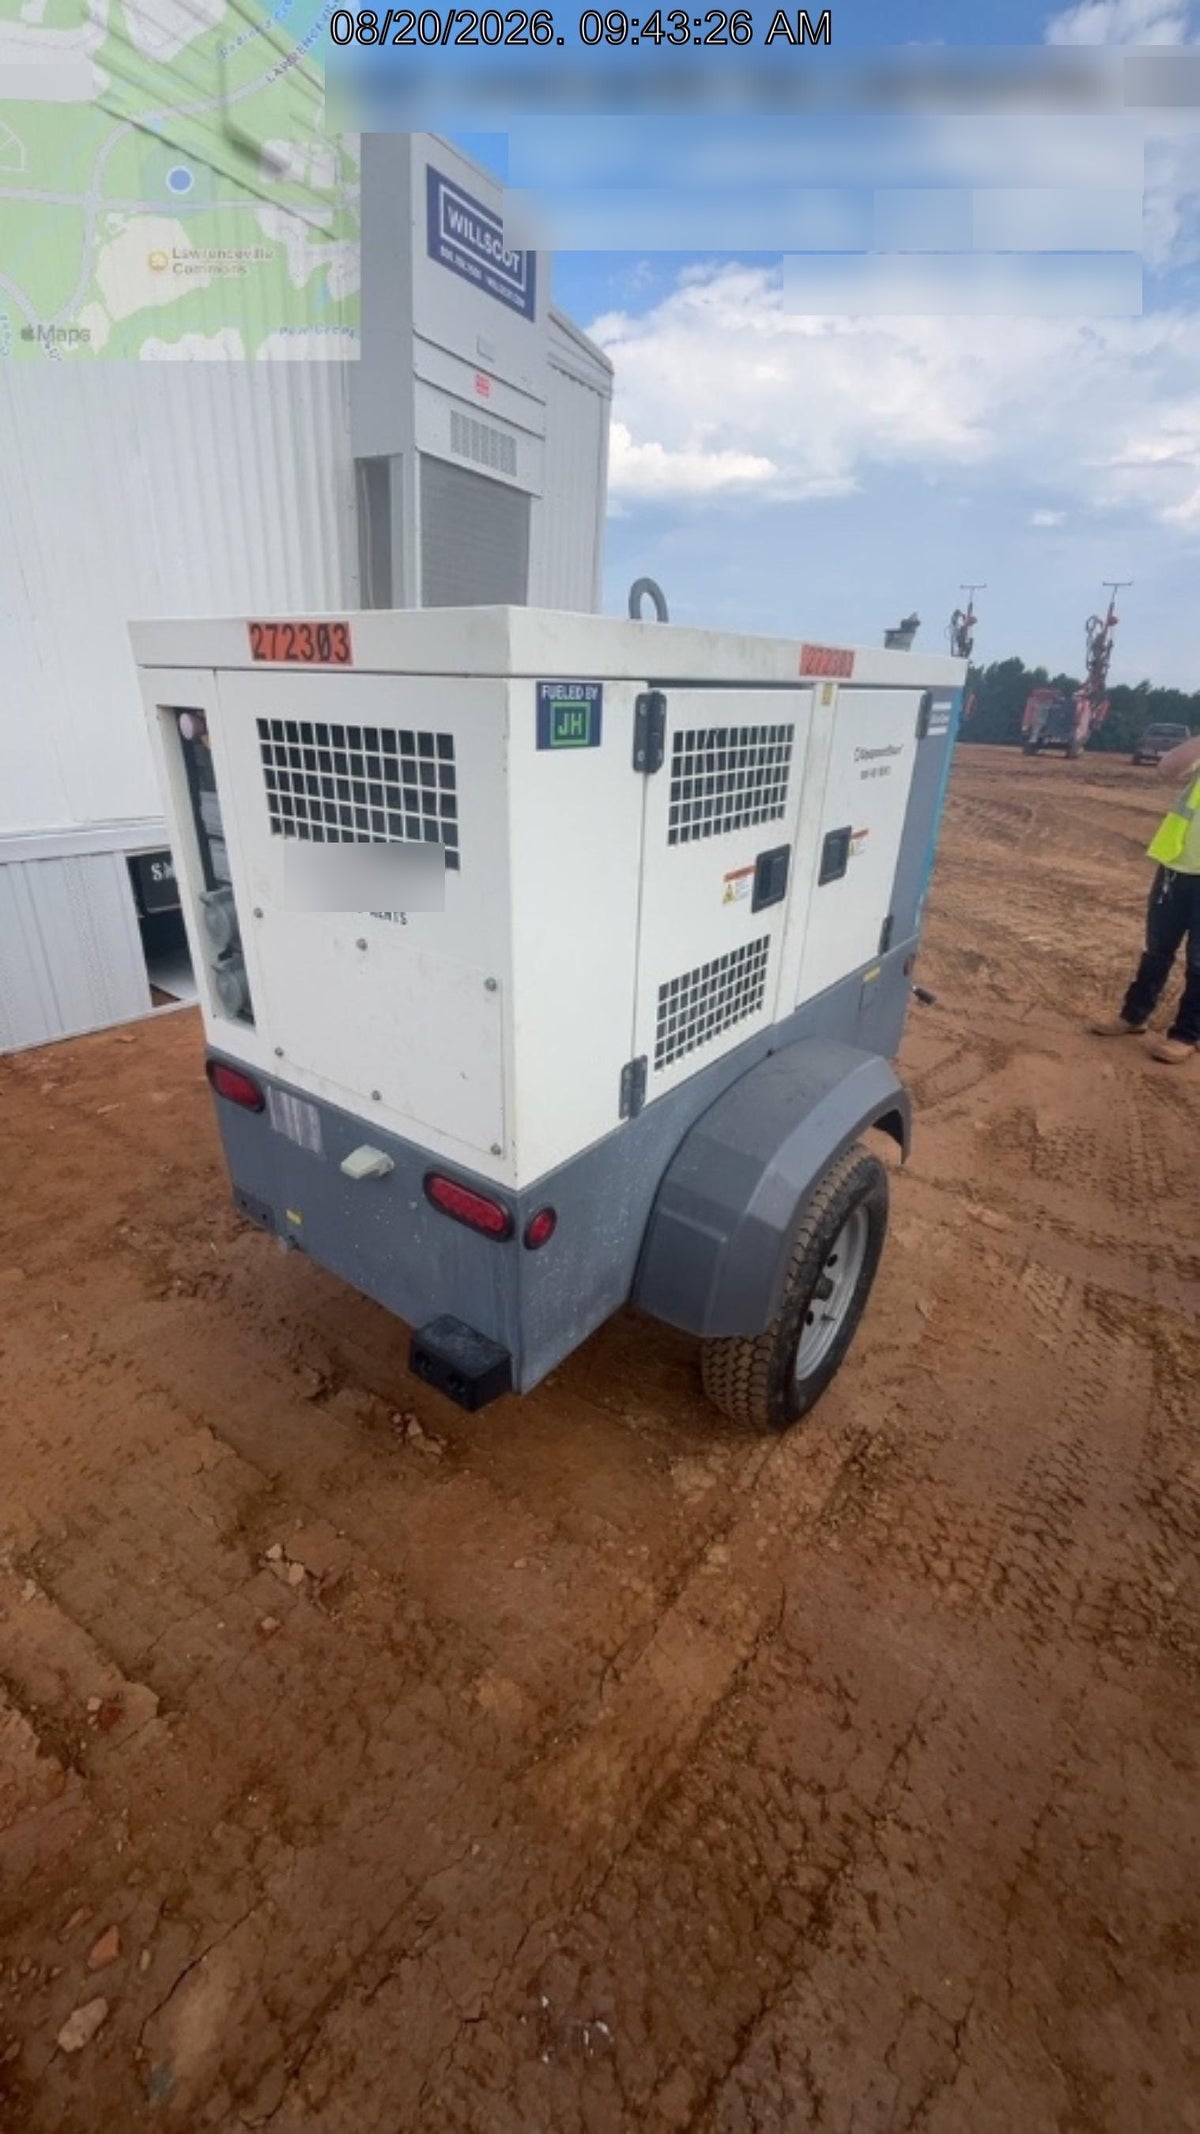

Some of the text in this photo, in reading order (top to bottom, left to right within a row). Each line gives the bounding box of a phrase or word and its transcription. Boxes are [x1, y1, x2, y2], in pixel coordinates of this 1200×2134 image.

[447, 203, 521, 273] WILLSCOT
[249, 622, 352, 663] 272303
[542, 684, 599, 700] FUELED BY
[558, 711, 583, 737] JH
